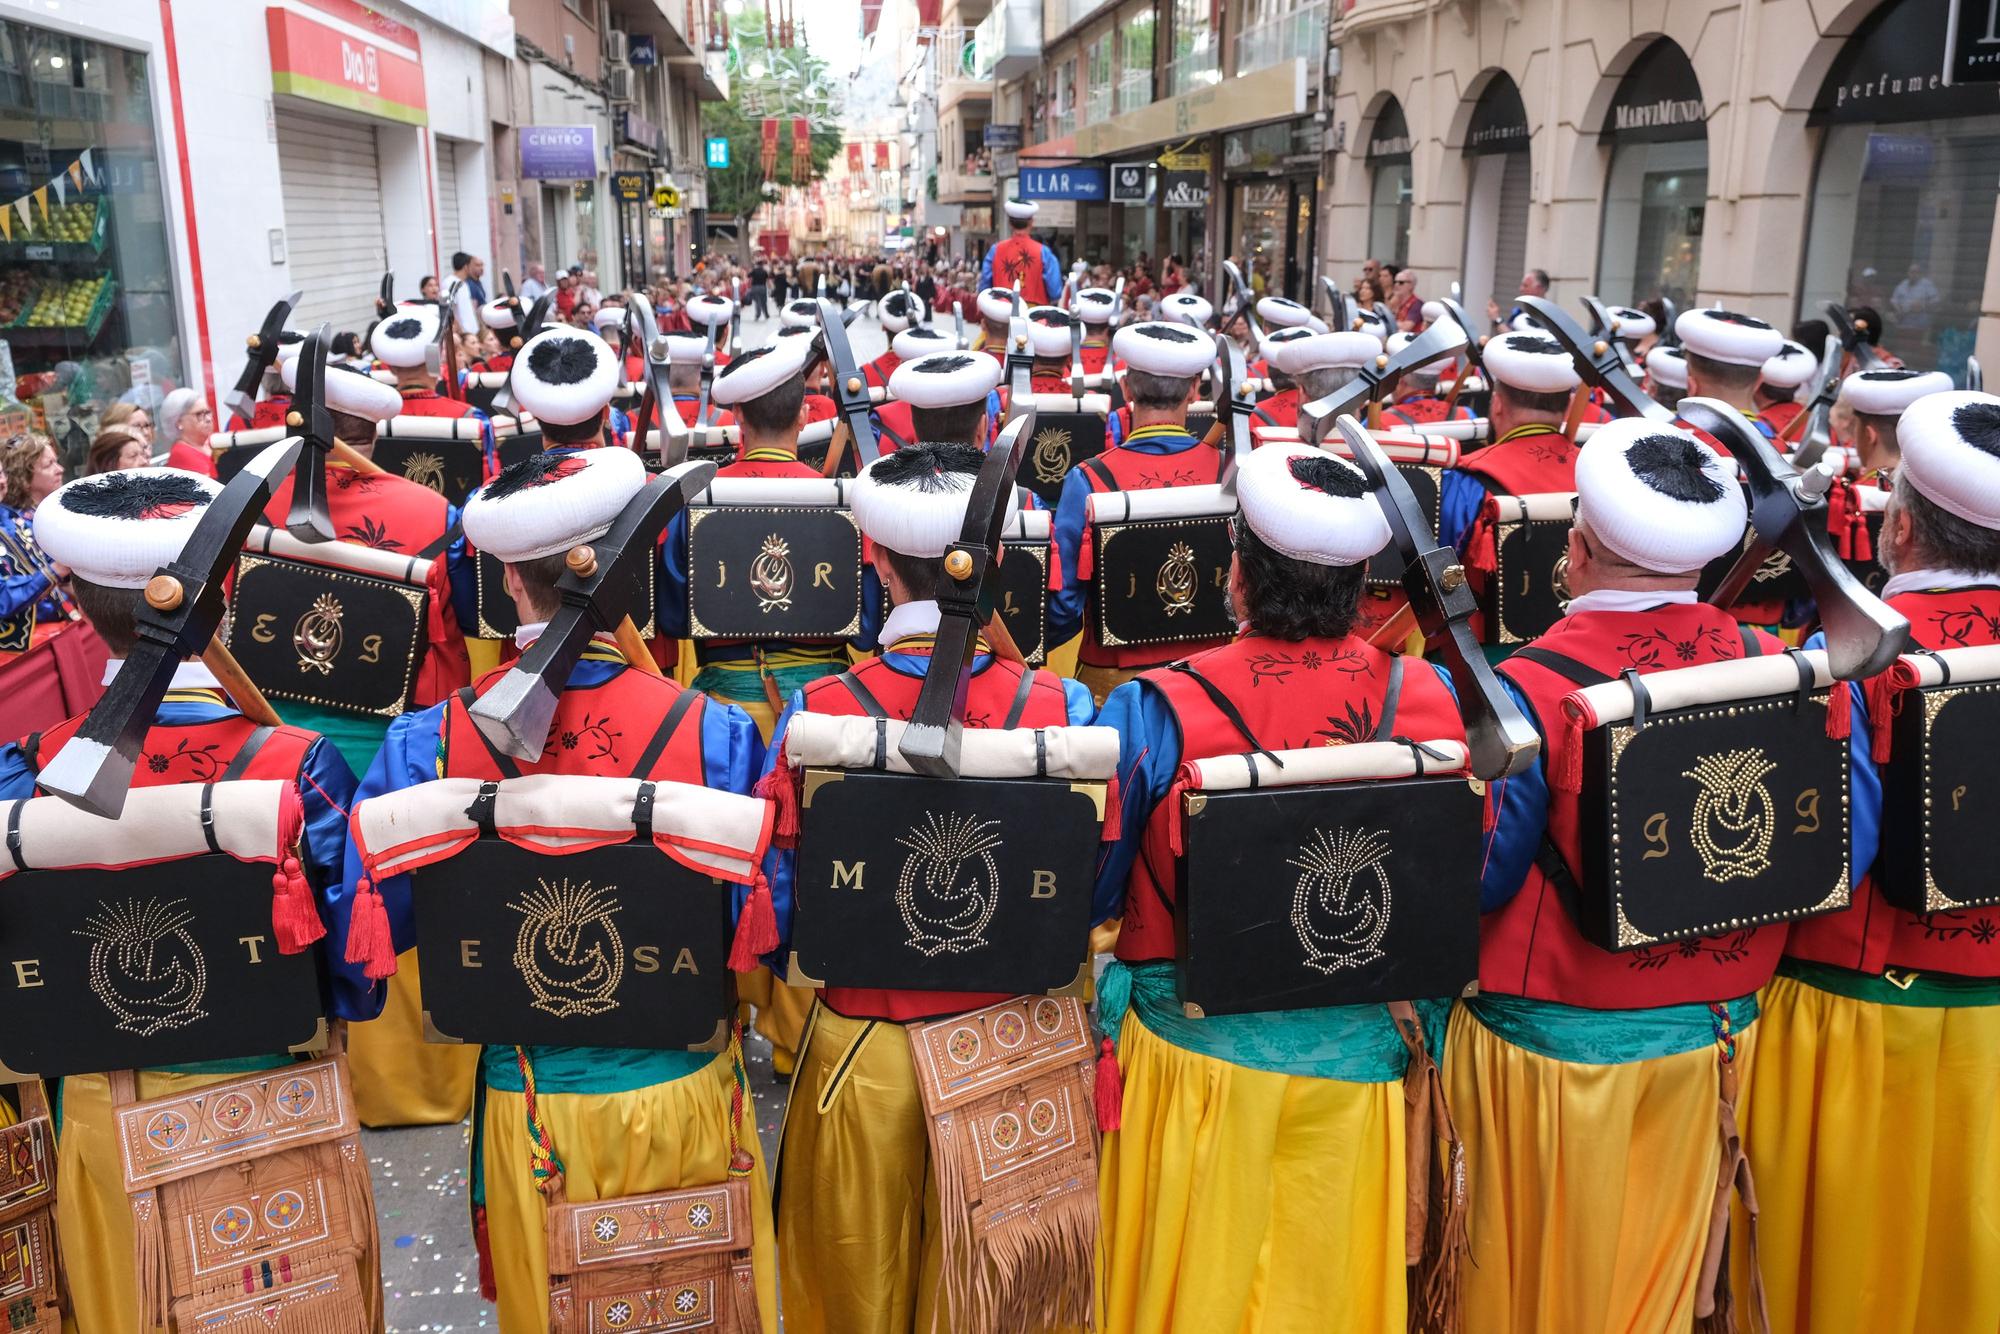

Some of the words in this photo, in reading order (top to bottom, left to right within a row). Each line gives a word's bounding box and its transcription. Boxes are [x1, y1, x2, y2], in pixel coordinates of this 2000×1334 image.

[529, 134, 583, 145] CENTRO
[1027, 173, 1070, 193] LLAR
[658, 193, 675, 205] IN
[813, 562, 835, 590] R
[830, 860, 866, 890] M
[1030, 870, 1057, 899] B
[11, 959, 44, 988] E
[239, 935, 265, 964] T
[460, 940, 483, 968] E
